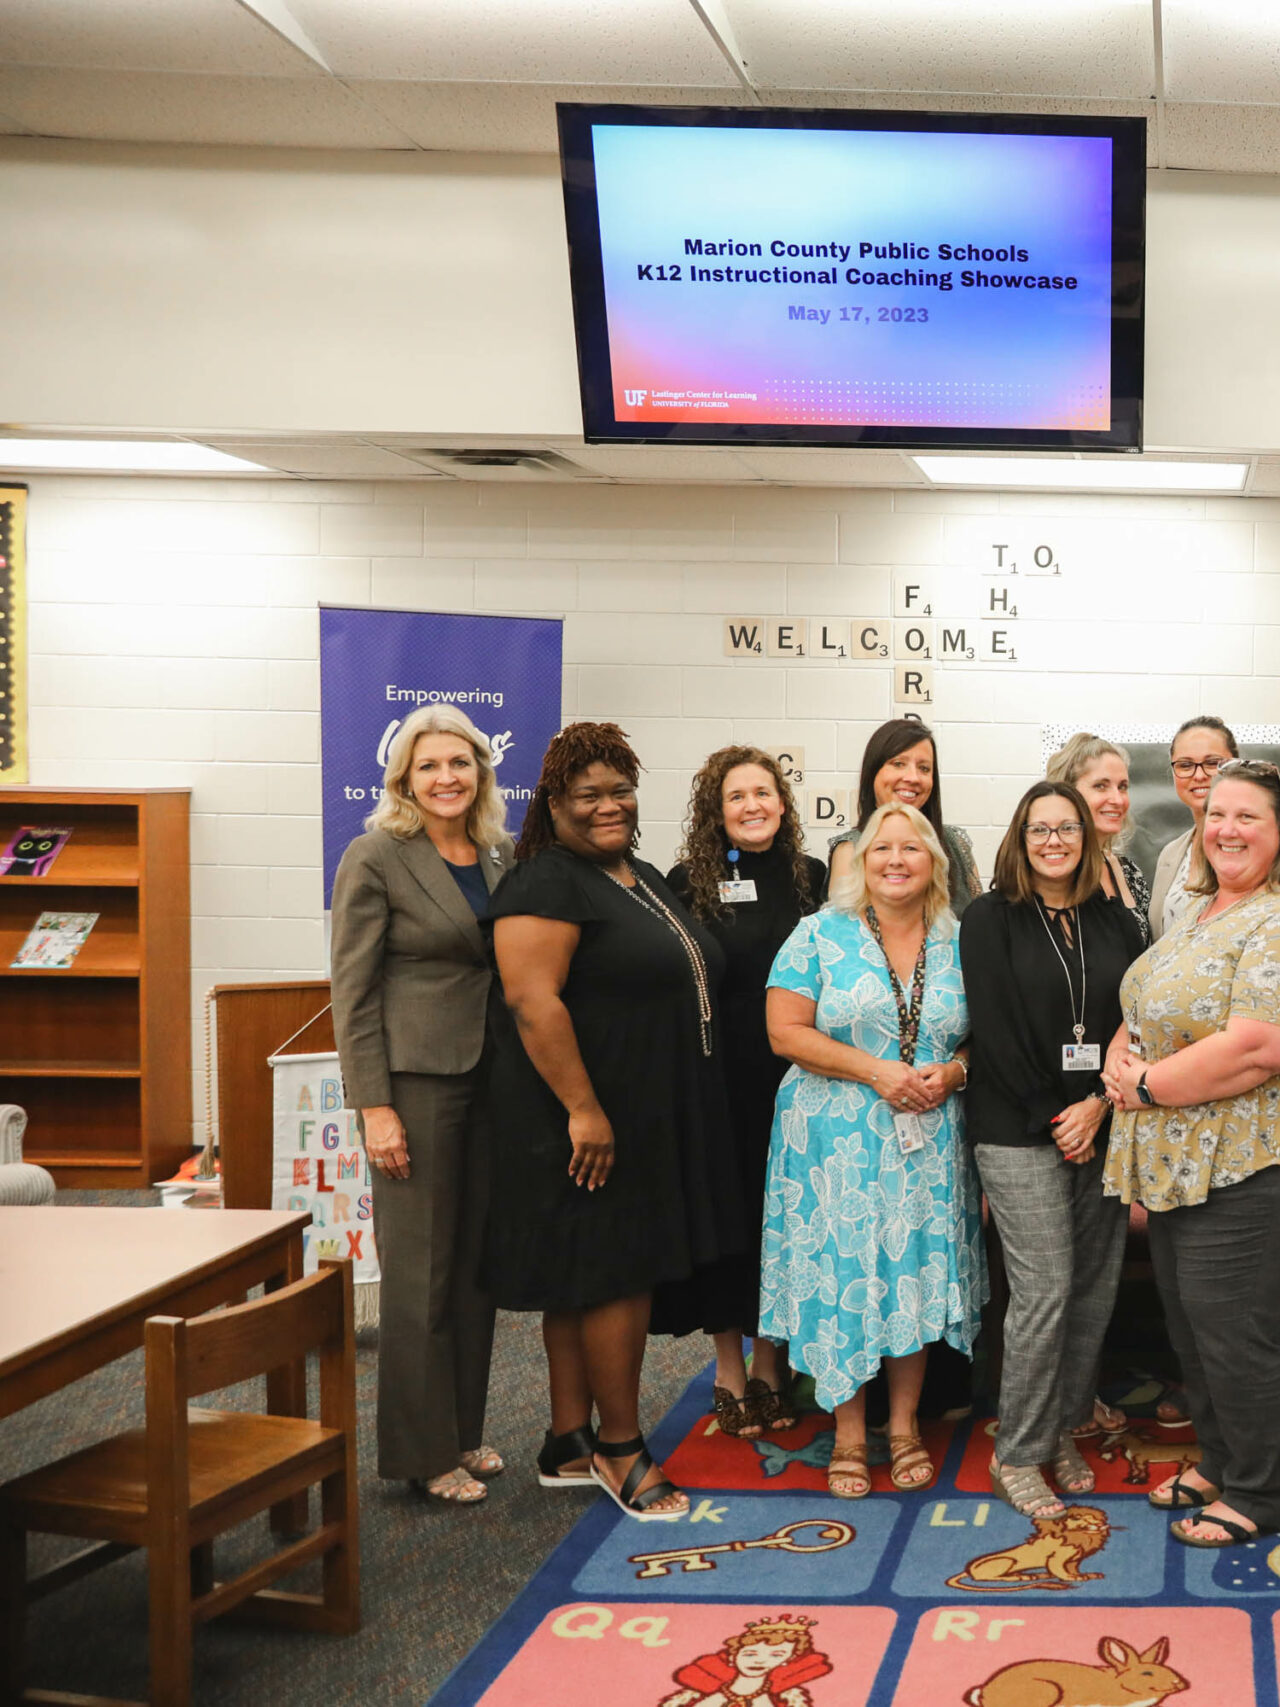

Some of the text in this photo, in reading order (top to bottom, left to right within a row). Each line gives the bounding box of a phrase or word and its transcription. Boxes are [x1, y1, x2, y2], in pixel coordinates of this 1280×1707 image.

[684, 239, 1029, 262] Marion County Public Schools
[637, 264, 1078, 291] K12 Instructional Coaching Showcase
[788, 305, 929, 324] May 17, 2023
[624, 389, 647, 406] UF
[651, 390, 757, 401] Lastinger Center for Learning
[992, 545, 1053, 568] TO
[729, 625, 1008, 654] WELCOME
[386, 685, 504, 708] Empowering
[344, 785, 365, 800] to
[816, 797, 835, 819] D
[296, 1079, 342, 1113] A B
[300, 1120, 316, 1151] F
[322, 1123, 339, 1151] G
[293, 1152, 358, 1192] K L M
[333, 1193, 350, 1224] R
[357, 1194, 374, 1220] S
[346, 1230, 363, 1260] X
[551, 1606, 671, 1647] Qq
[932, 1610, 1025, 1641] Rr
